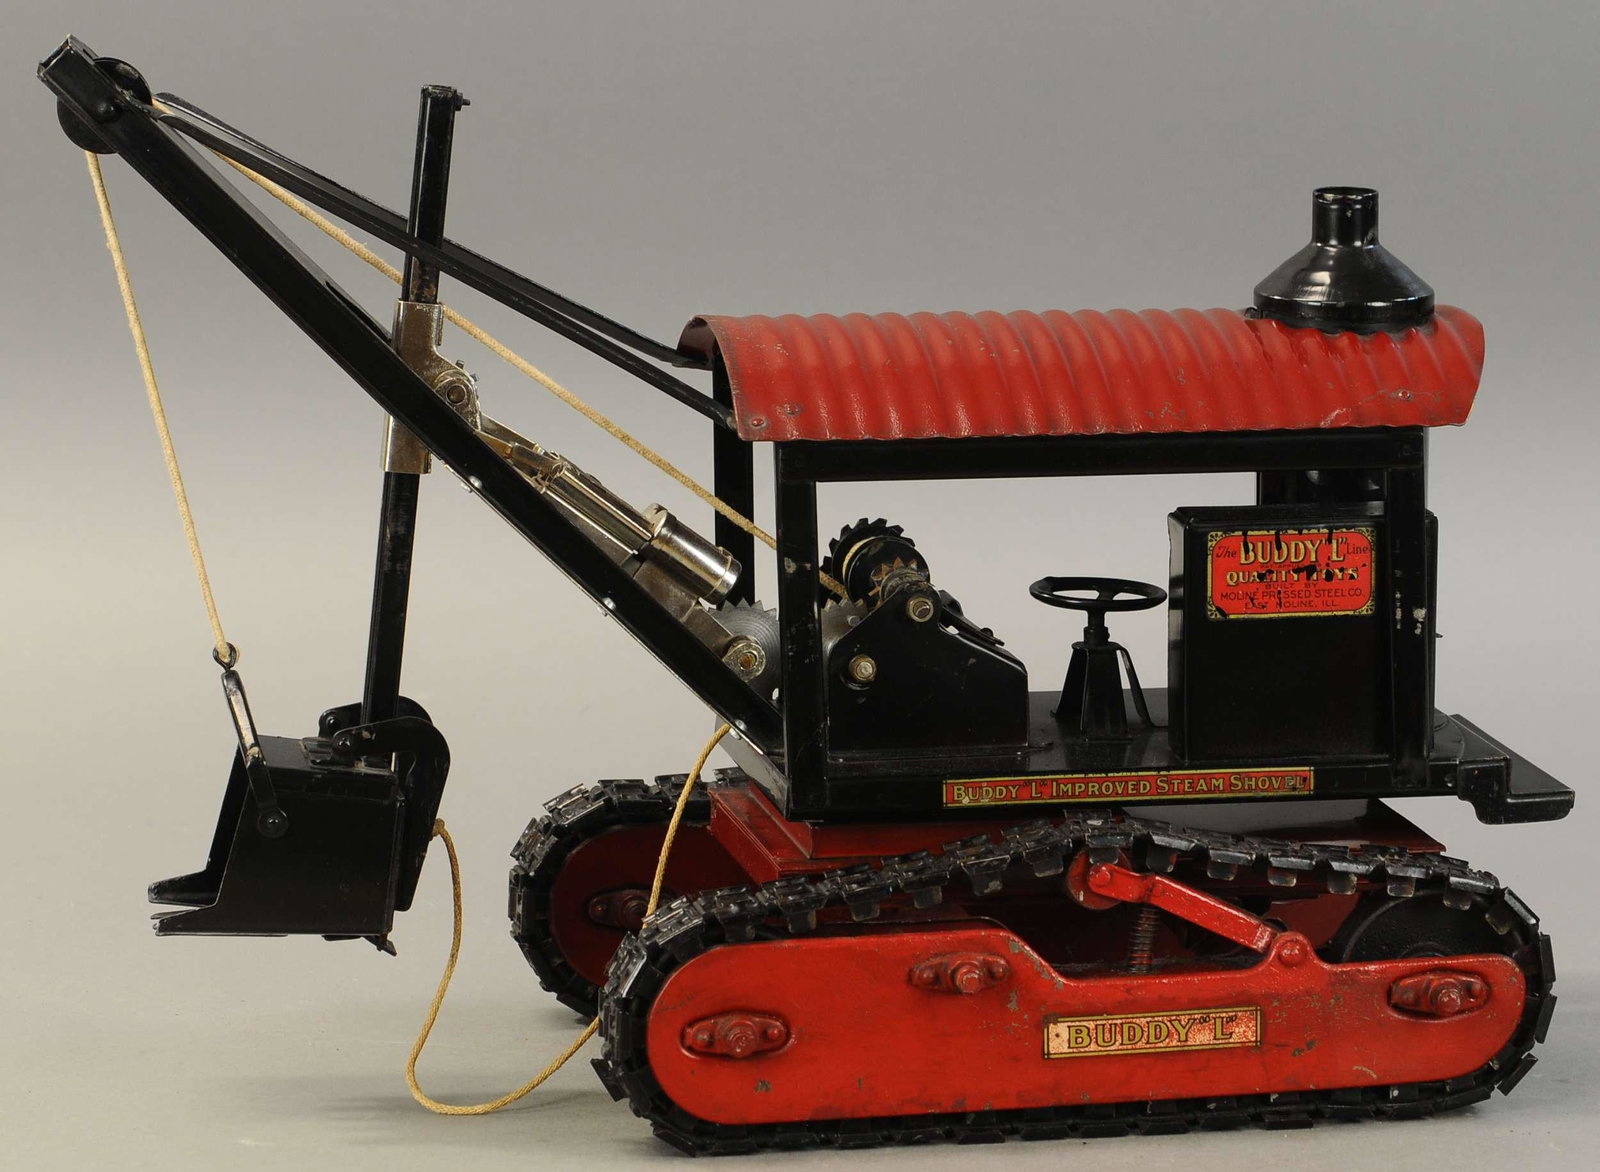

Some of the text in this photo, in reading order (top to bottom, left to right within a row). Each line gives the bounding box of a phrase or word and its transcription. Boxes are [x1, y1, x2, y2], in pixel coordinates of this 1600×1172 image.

[1215, 545, 1237, 558] The
[1239, 540, 1322, 565] BUDDY
[1346, 543, 1369, 555] Line
[1220, 592, 1260, 601] MOLINE
[1261, 589, 1312, 599] PRESSED
[1314, 588, 1346, 598] STEEL
[953, 784, 1020, 803] BUDDY
[1052, 779, 1151, 797] IMPROVED
[1156, 777, 1225, 794] STEAM
[1230, 775, 1307, 791] SHOVEL
[1067, 1018, 1195, 1049] BUDDY
